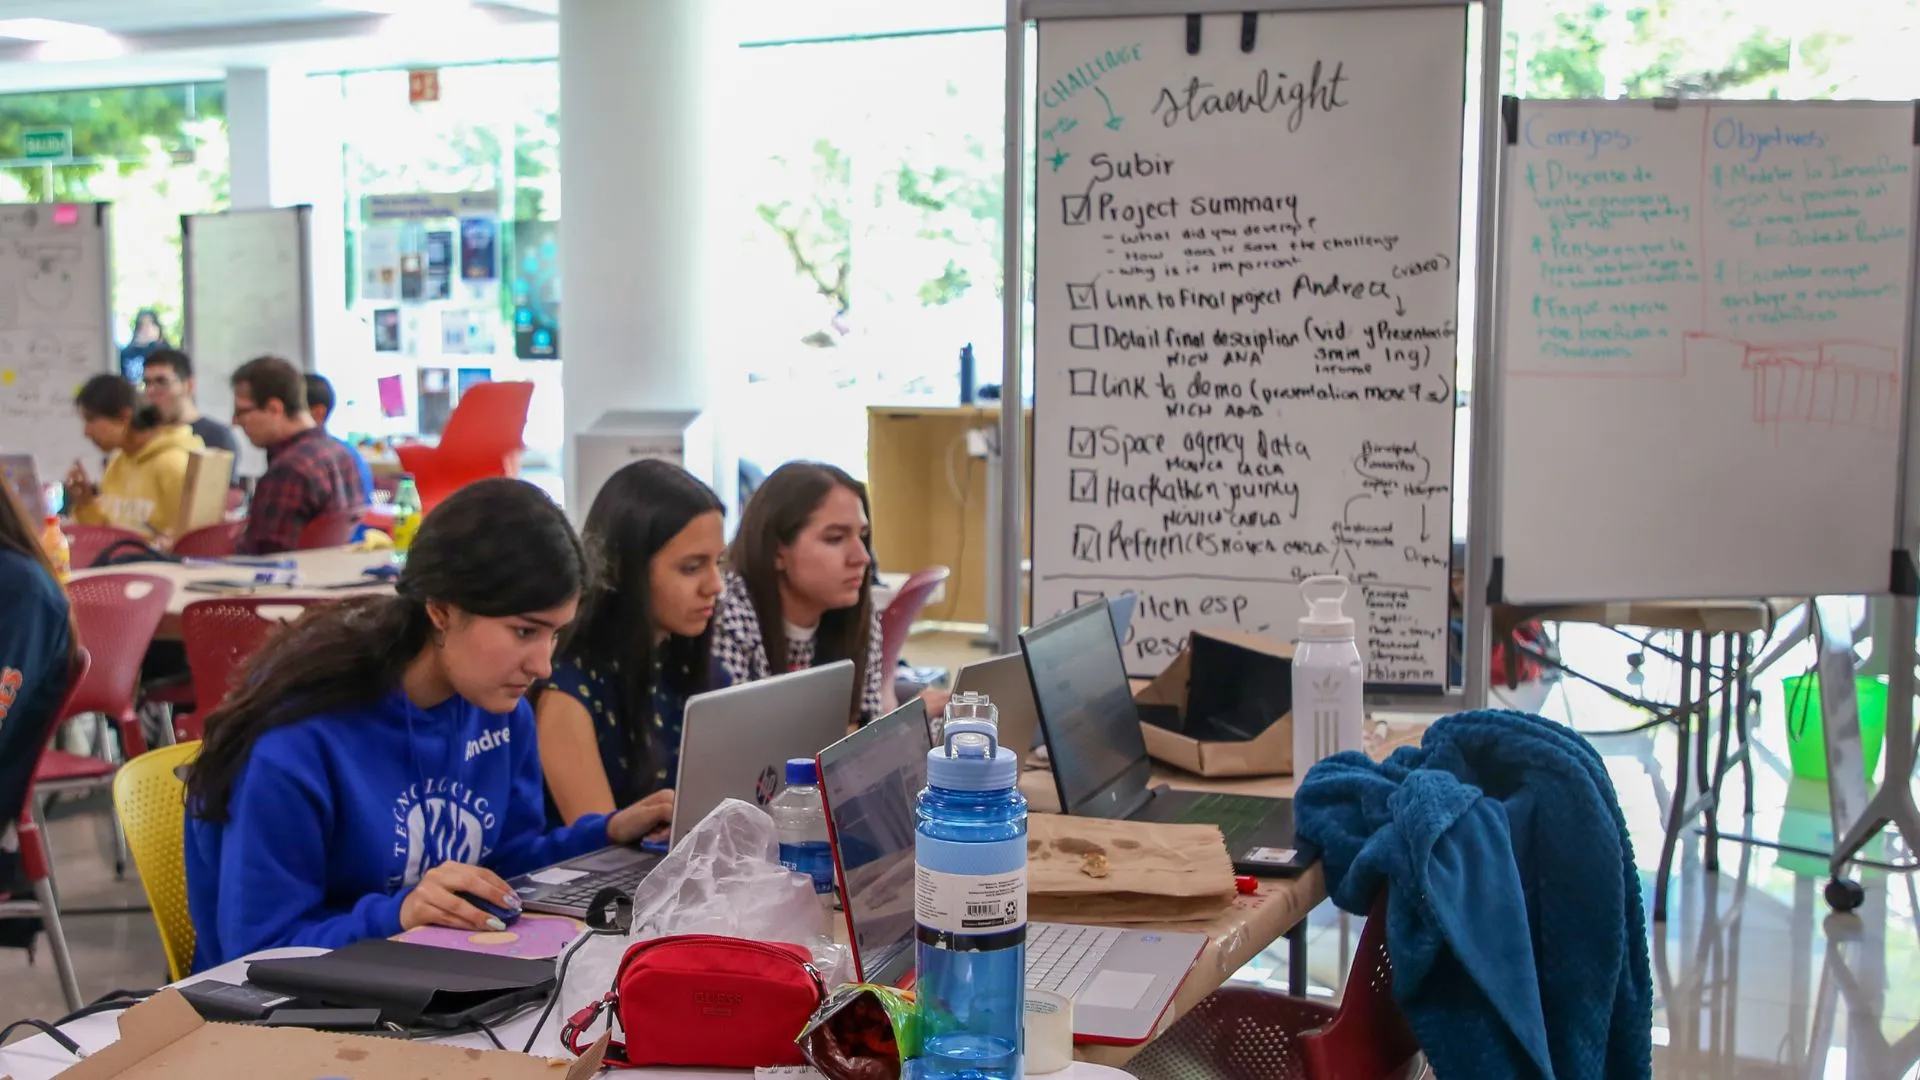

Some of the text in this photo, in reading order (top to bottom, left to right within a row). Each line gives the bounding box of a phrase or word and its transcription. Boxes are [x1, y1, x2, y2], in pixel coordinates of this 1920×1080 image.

[1091, 151, 1175, 183] Subir
[1100, 193, 1179, 229] Project
[1157, 290, 1176, 309] to
[1231, 287, 1282, 316] project
[1293, 272, 1392, 301] Andrea
[1104, 325, 1160, 350] Detail
[1156, 371, 1177, 400] to
[1187, 371, 1243, 399] demo
[1100, 424, 1166, 466] Space
[1183, 429, 1245, 464] agency
[1106, 473, 1220, 508] Hackathon
[1199, 594, 1248, 624] esp
